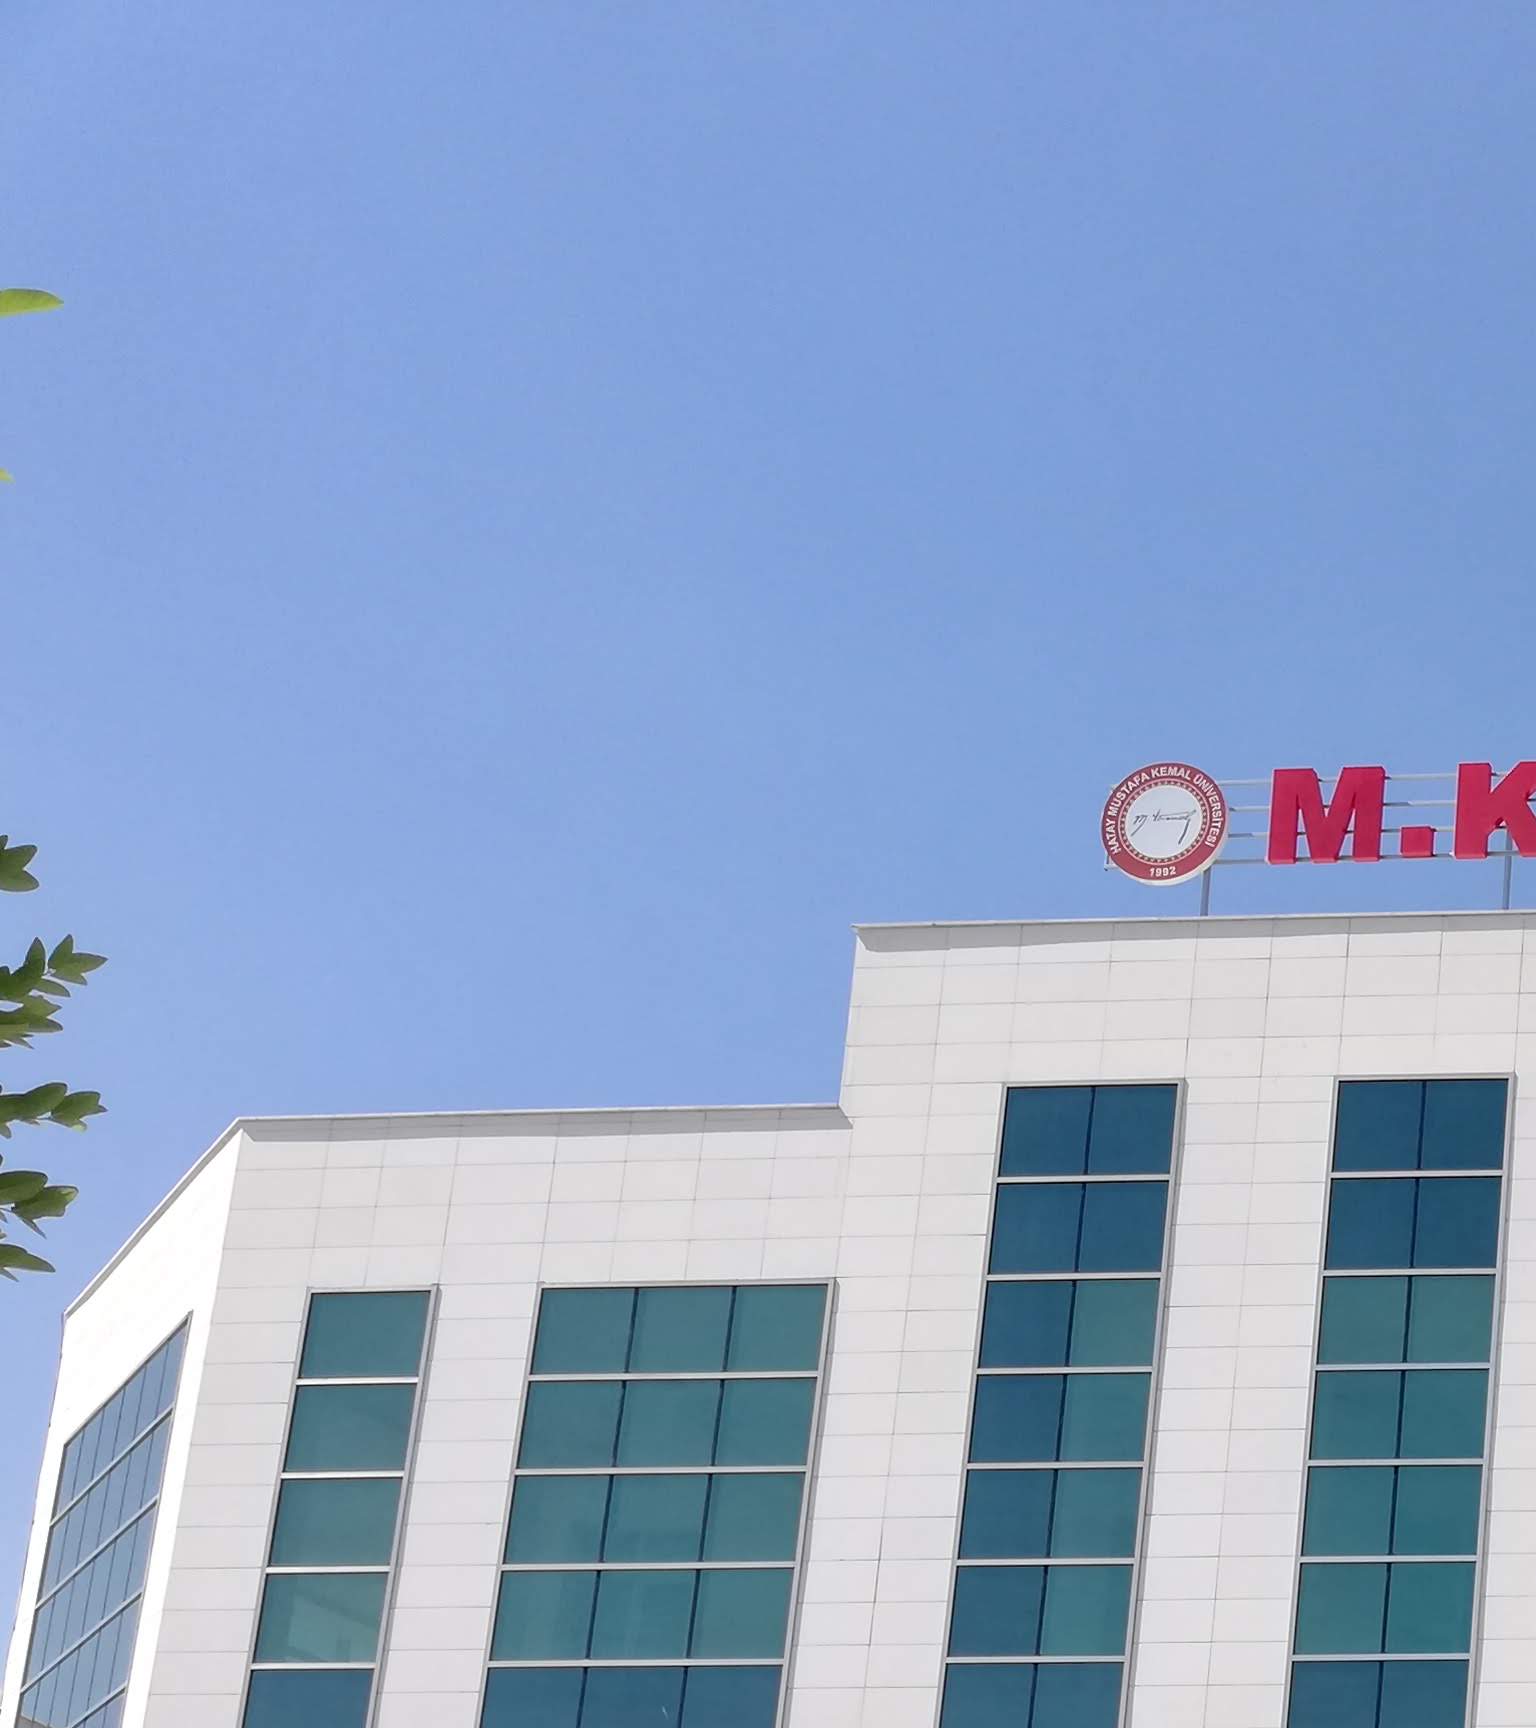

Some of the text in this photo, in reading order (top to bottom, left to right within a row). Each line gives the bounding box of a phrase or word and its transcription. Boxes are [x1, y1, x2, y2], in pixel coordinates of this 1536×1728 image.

[1150, 766, 1192, 781] KEMAL
[1107, 772, 1151, 817] MUSTAFA
[1105, 818, 1122, 855] HATAY
[1149, 866, 1177, 878] 1992
